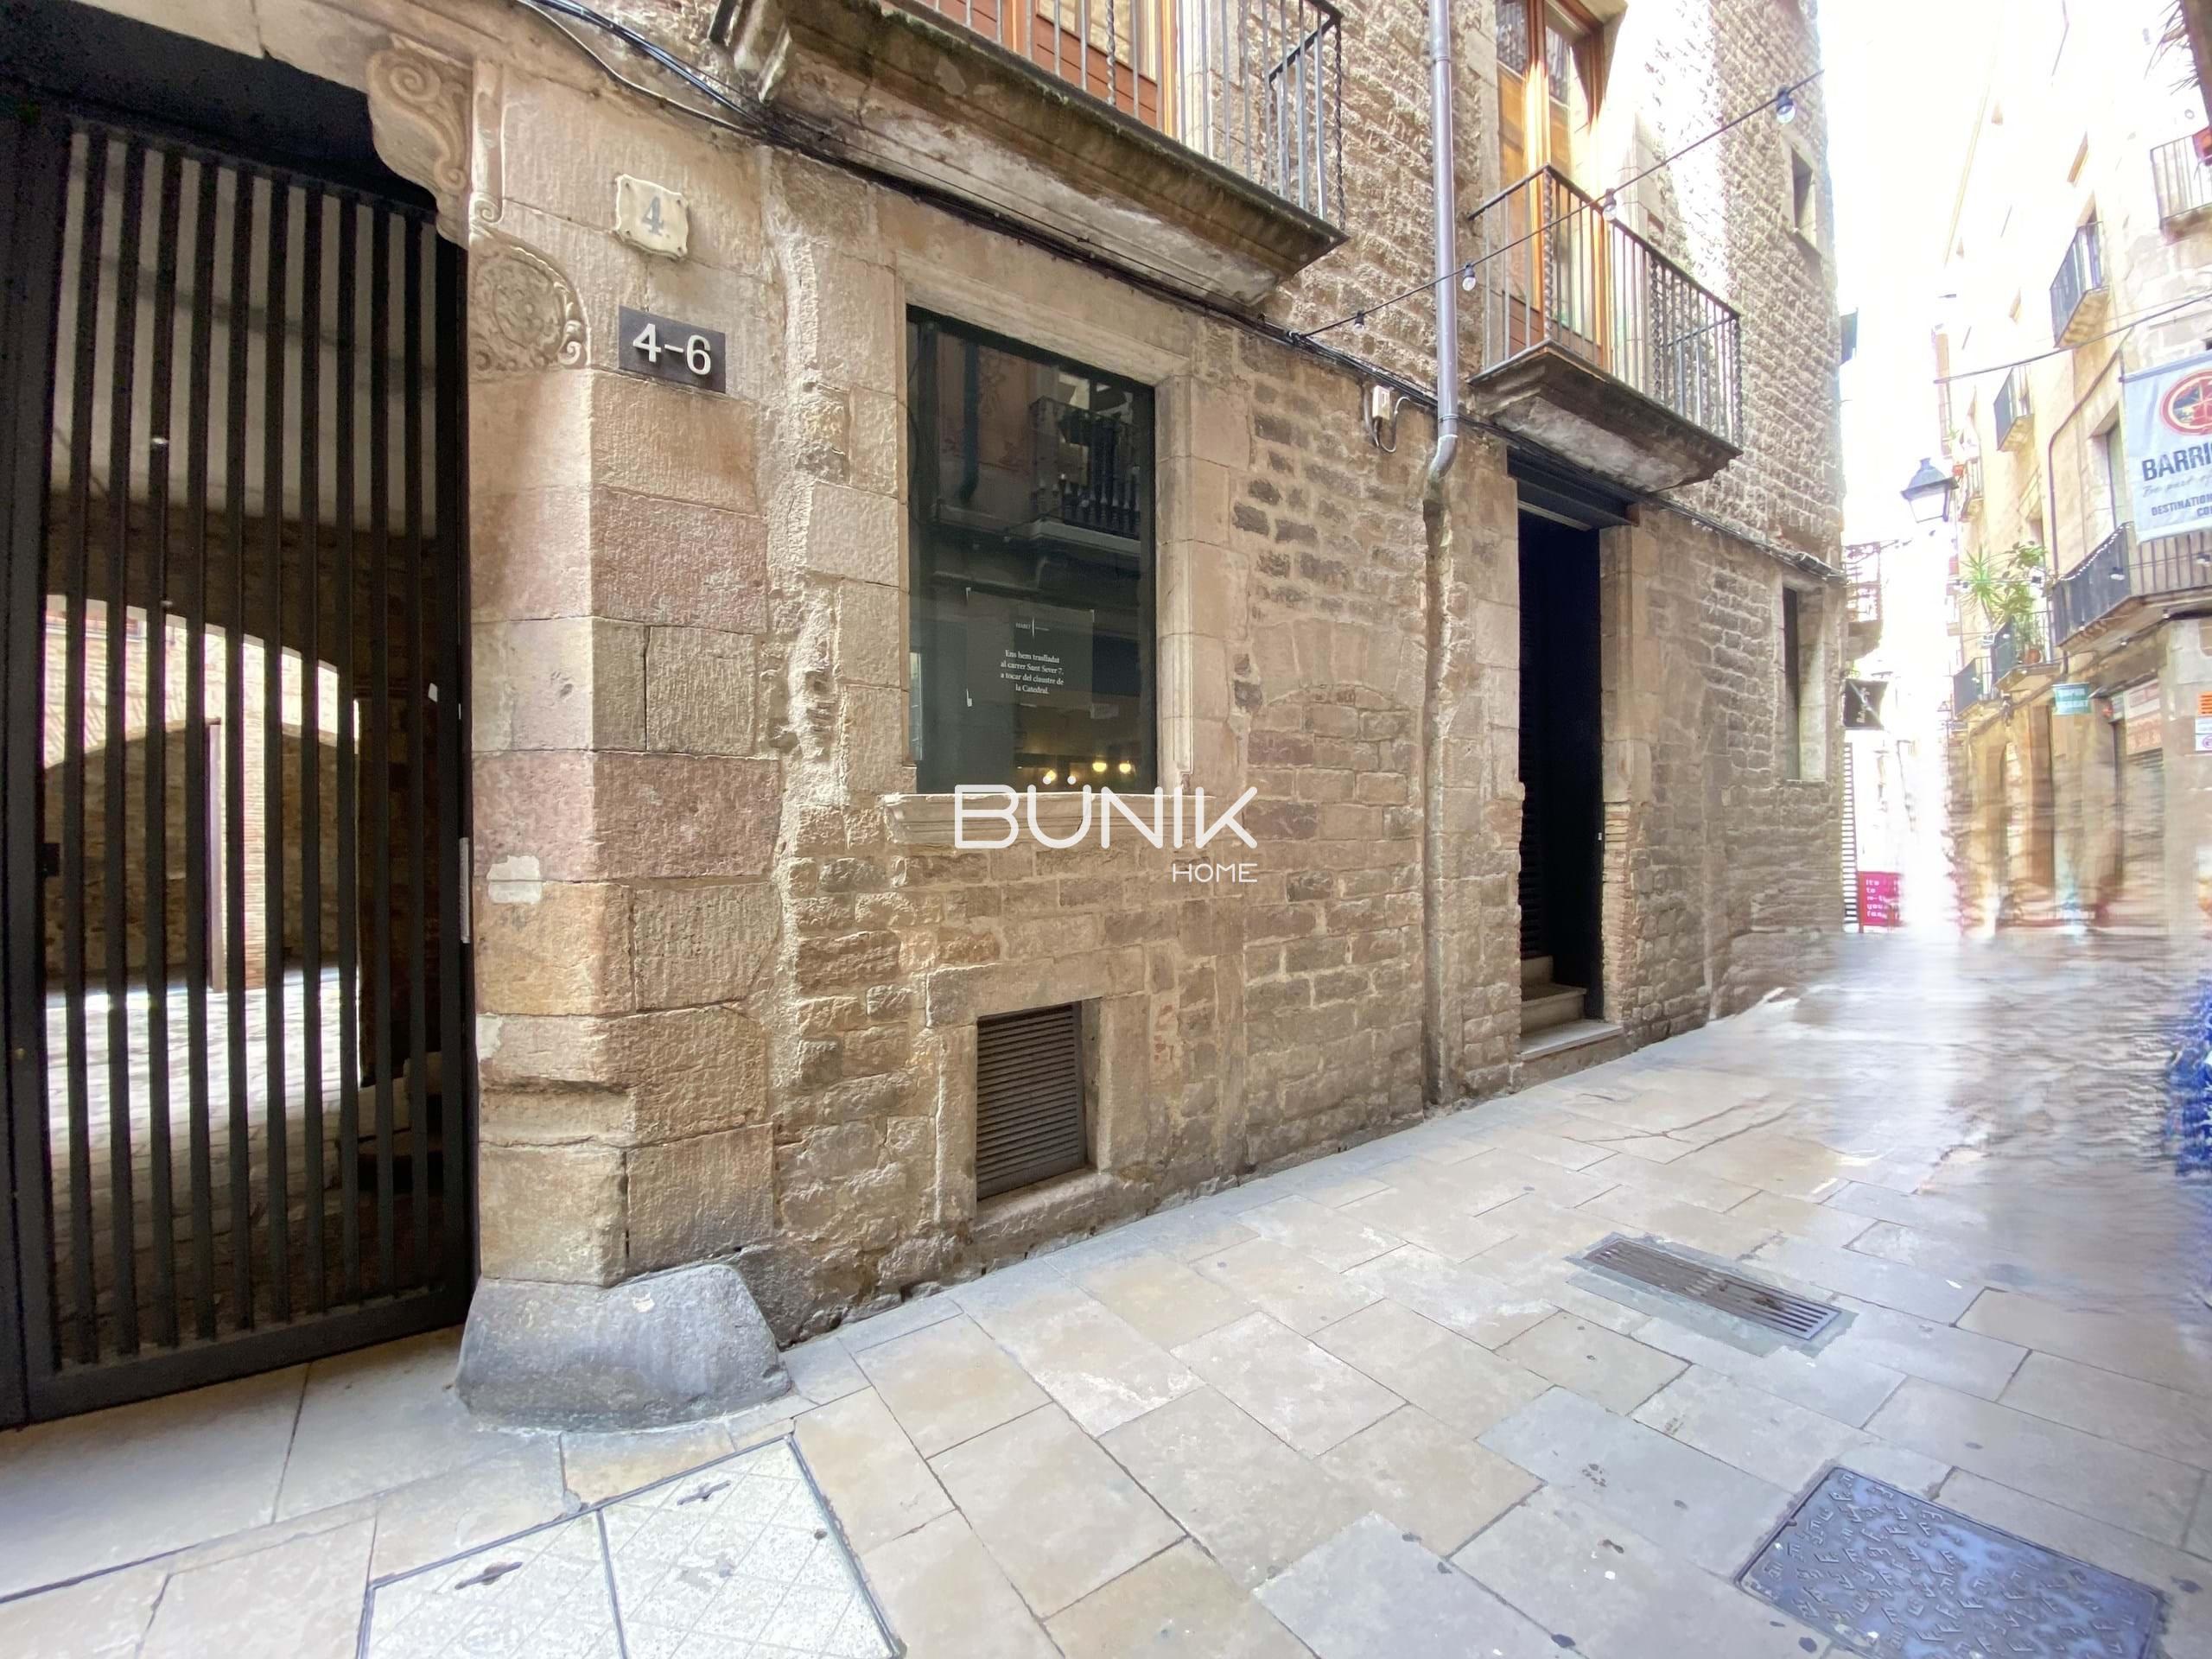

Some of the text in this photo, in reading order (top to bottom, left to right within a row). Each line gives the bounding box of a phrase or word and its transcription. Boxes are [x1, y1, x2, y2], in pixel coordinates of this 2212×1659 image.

[641, 195, 664, 238] 4
[632, 322, 712, 376] 4-6
[2141, 442, 2212, 481] BARRI
[1027, 663, 1040, 671] Sant
